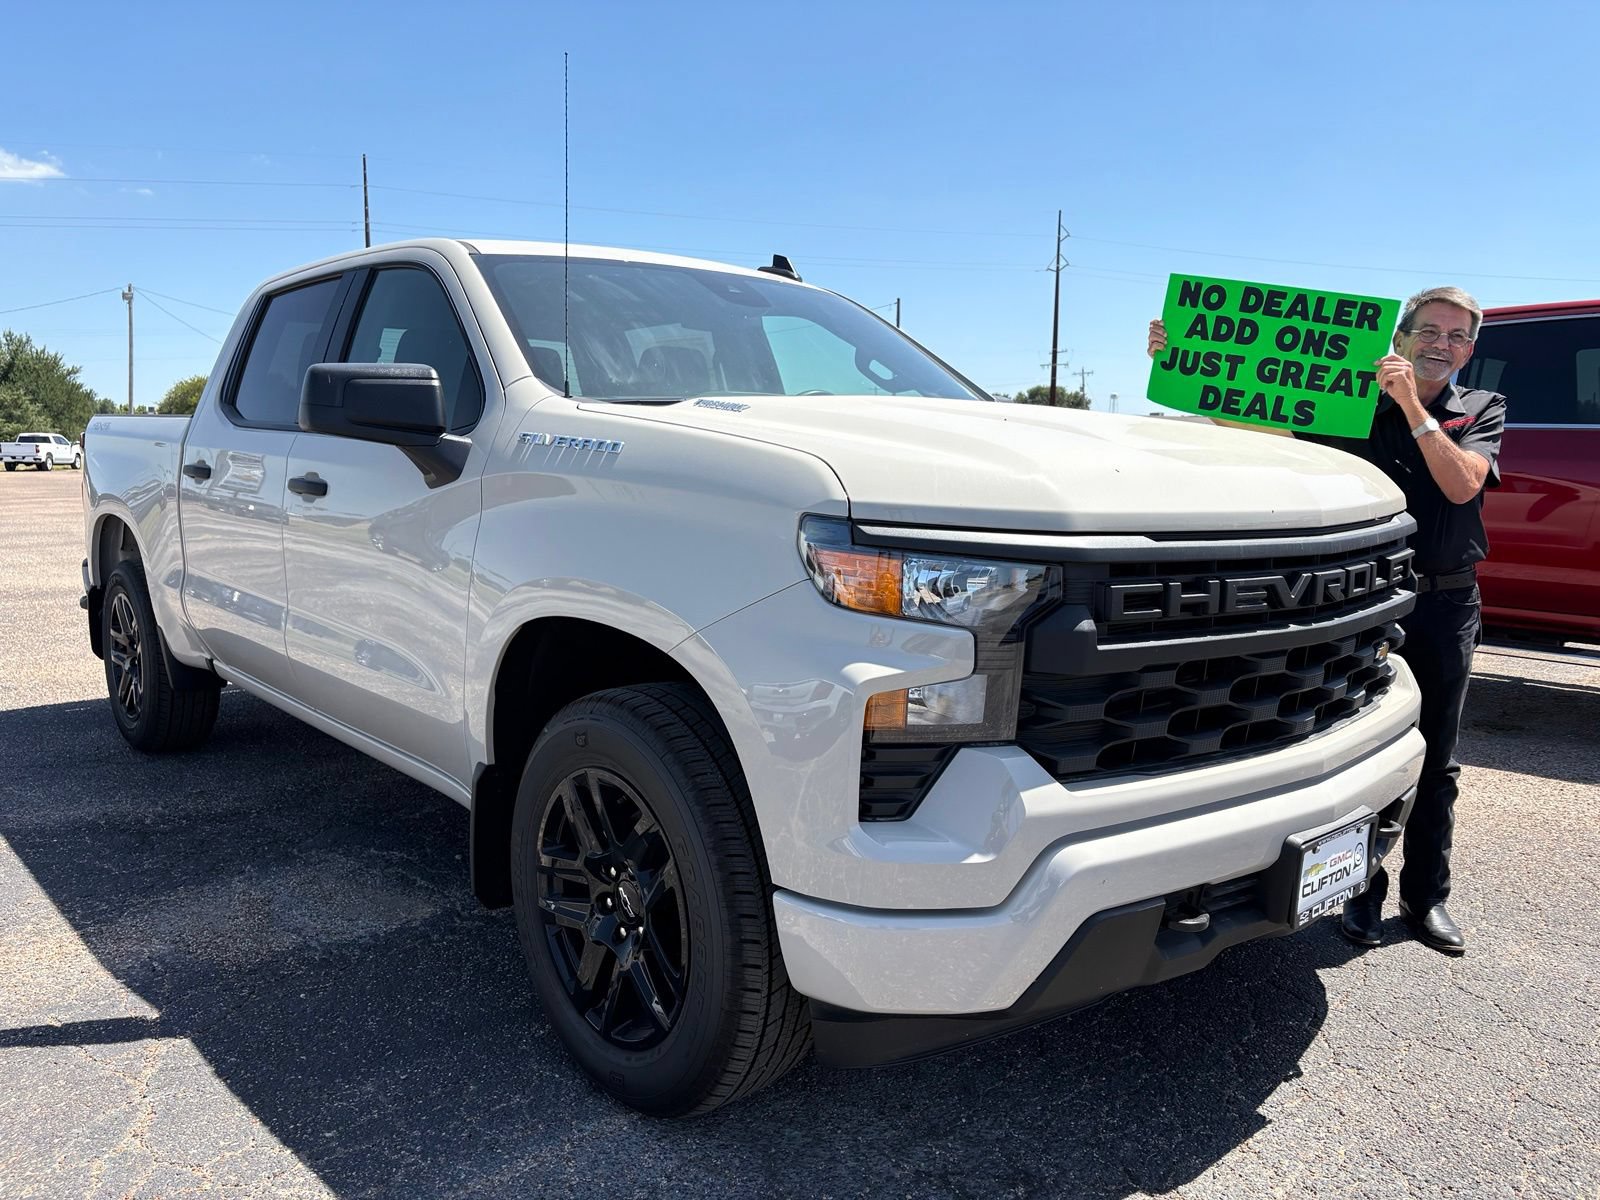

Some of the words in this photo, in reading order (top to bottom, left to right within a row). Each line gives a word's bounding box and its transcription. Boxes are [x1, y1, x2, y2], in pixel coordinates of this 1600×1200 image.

[1178, 281, 1226, 311] NO
[1239, 286, 1381, 331] DEALER
[1185, 314, 1259, 345] ADD
[1276, 326, 1349, 360] ONS
[1160, 347, 1245, 380] JUST
[1257, 358, 1377, 398] GREAT
[1198, 385, 1315, 427] DEALS
[519, 432, 625, 454] SILVERADO
[1329, 850, 1353, 868] GMC
[1301, 864, 1352, 898] CLIFTON
[1311, 887, 1354, 918] CLIFTON
